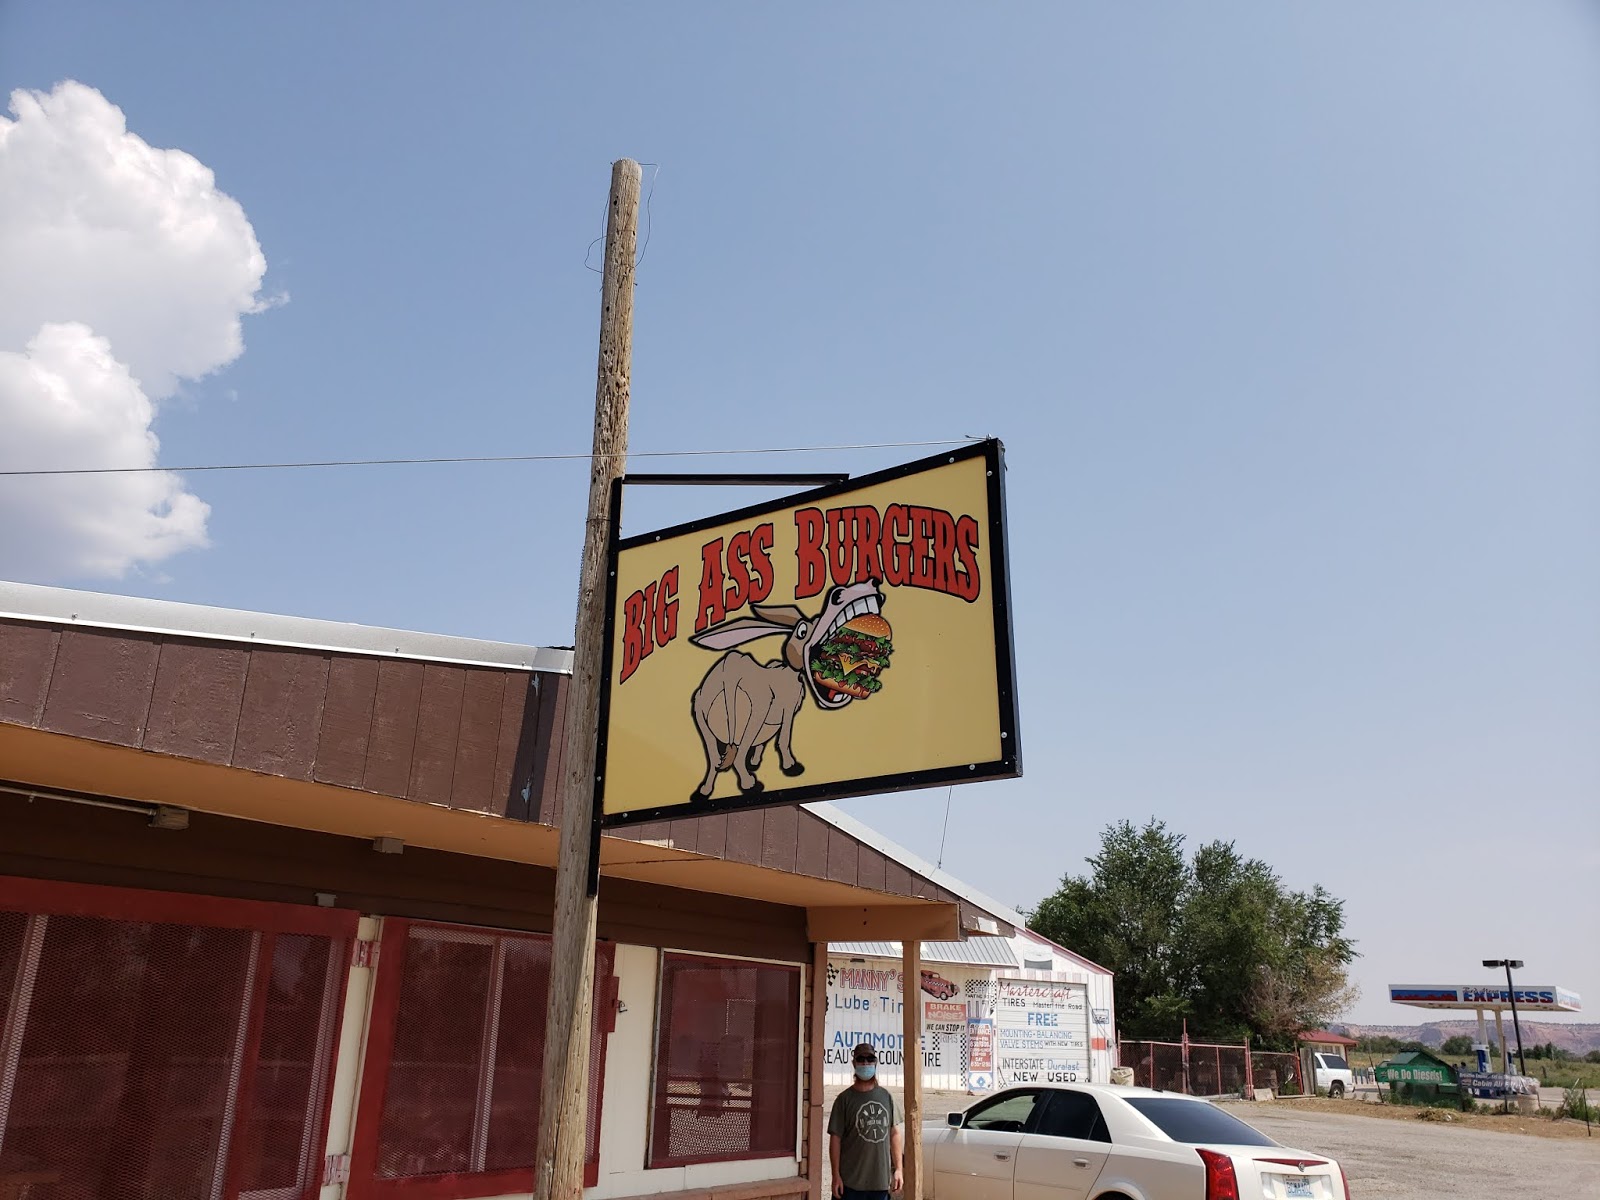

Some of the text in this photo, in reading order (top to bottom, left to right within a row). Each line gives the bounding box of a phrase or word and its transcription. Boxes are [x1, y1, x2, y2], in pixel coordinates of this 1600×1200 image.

[619, 503, 980, 685] BIG ASS BURGERS
[1002, 997, 1026, 1007] TIRES
[1463, 991, 1554, 1003] EXPRESS
[834, 993, 870, 1010] Lube
[880, 996, 904, 1014] Tir
[930, 1003, 962, 1011] BRAKE
[1027, 1012, 1059, 1026] FREE
[926, 1023, 934, 1031] WE
[935, 1023, 945, 1032] CAN
[946, 1024, 960, 1032] STOP
[1000, 1040, 1020, 1048] VALVE
[1022, 1040, 1044, 1049] STEMS
[1002, 1058, 1044, 1070] INTERSTATE
[1047, 1059, 1080, 1071] Duralast
[1013, 1071, 1077, 1083] NEW USED
[1387, 1069, 1399, 1079] We
[1401, 1069, 1411, 1080] Do
